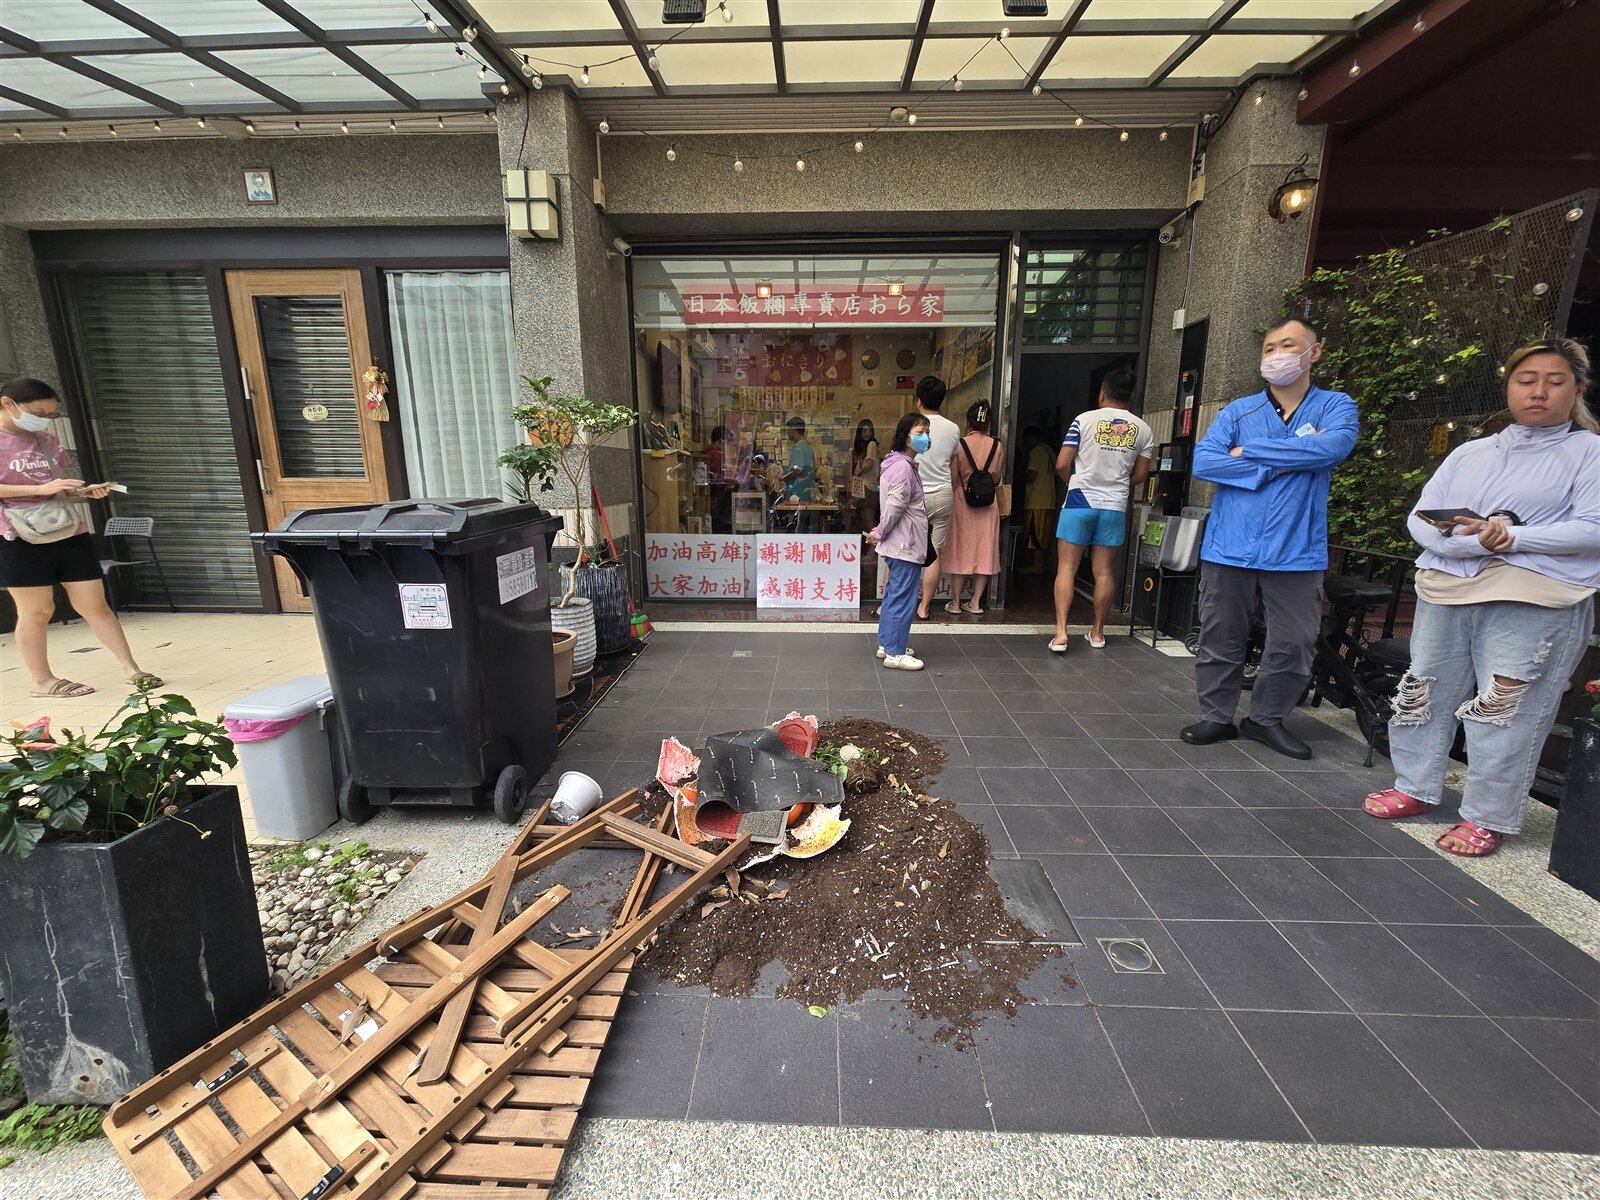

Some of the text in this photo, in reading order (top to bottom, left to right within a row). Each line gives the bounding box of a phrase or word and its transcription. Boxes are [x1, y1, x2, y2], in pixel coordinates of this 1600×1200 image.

[687, 291, 942, 317] 日本飯糰專賣店おら家
[647, 539, 744, 564] 加油高雄
[759, 541, 858, 566] 謝謝關心
[649, 573, 744, 597] 大家加油
[760, 576, 859, 603] 感謝支持
